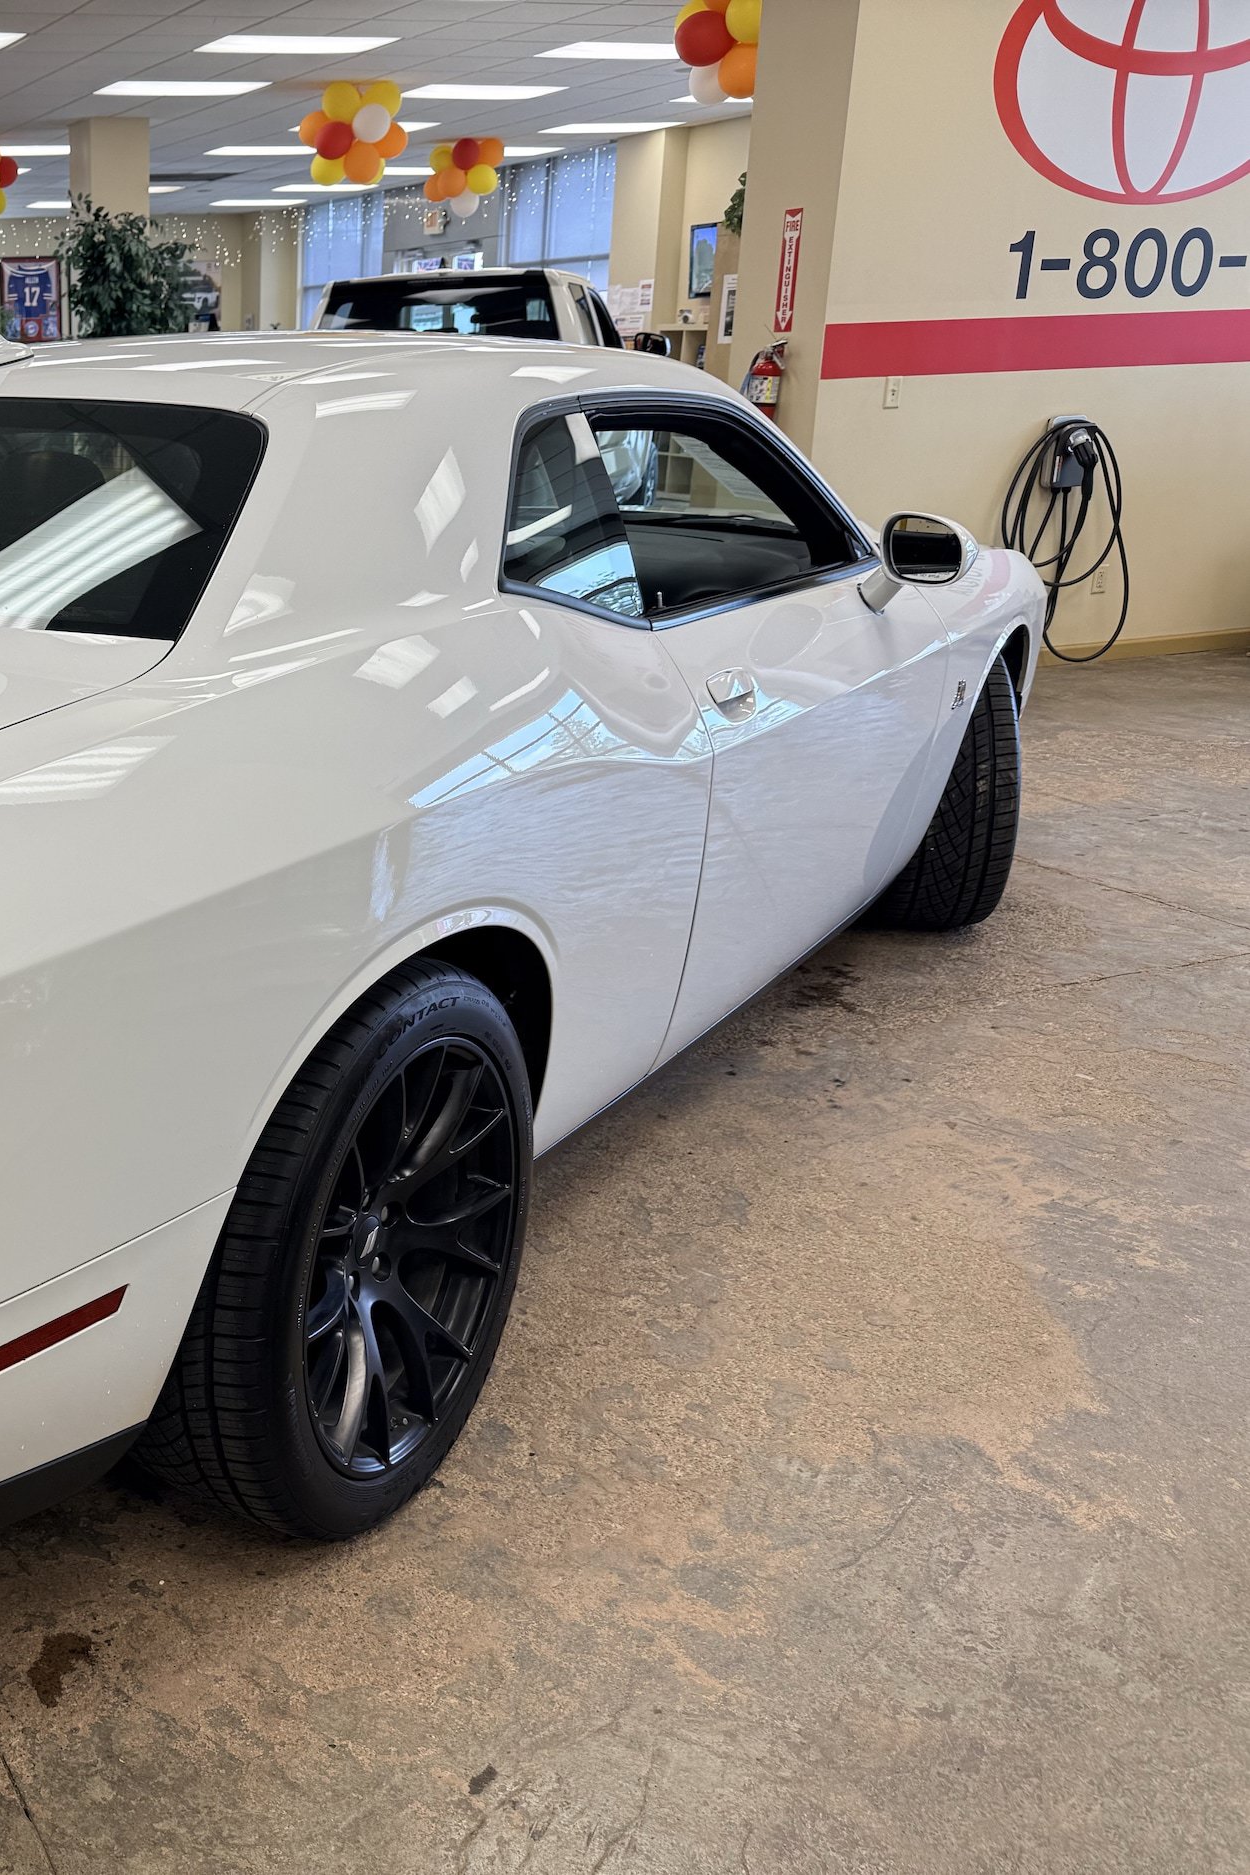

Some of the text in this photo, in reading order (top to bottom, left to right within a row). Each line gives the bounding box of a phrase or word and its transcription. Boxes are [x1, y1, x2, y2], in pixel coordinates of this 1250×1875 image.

[785, 220, 800, 232] FIRE
[780, 236, 794, 323] EXTINGUISHER
[1009, 226, 1248, 299] 1-800-
[23, 286, 41, 307] 17
